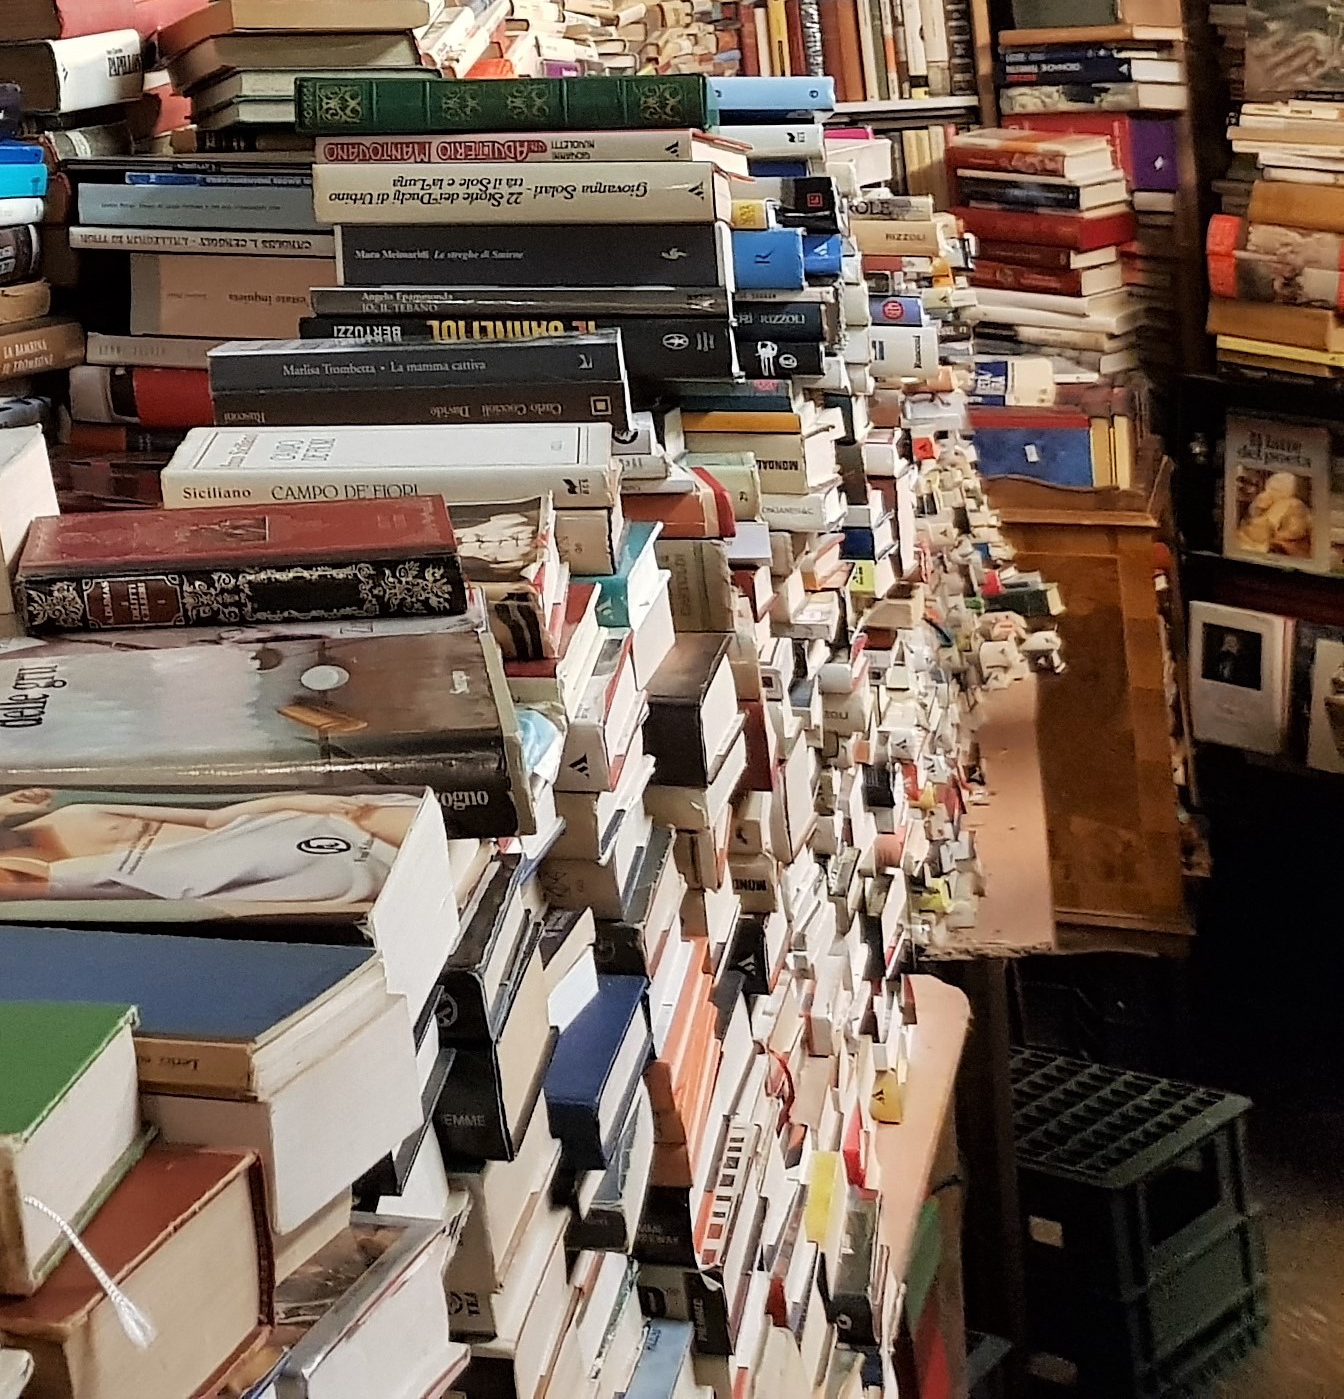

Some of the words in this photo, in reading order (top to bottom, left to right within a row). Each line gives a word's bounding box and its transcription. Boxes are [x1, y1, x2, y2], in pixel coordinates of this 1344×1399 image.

[760, 312, 806, 325] RIZZOLI
[283, 363, 320, 378] Marlisa
[389, 360, 403, 374] La
[407, 360, 449, 374] mamma
[451, 359, 486, 374] cattiva
[183, 486, 252, 500] Siciliano
[272, 484, 337, 501] CAMPO
